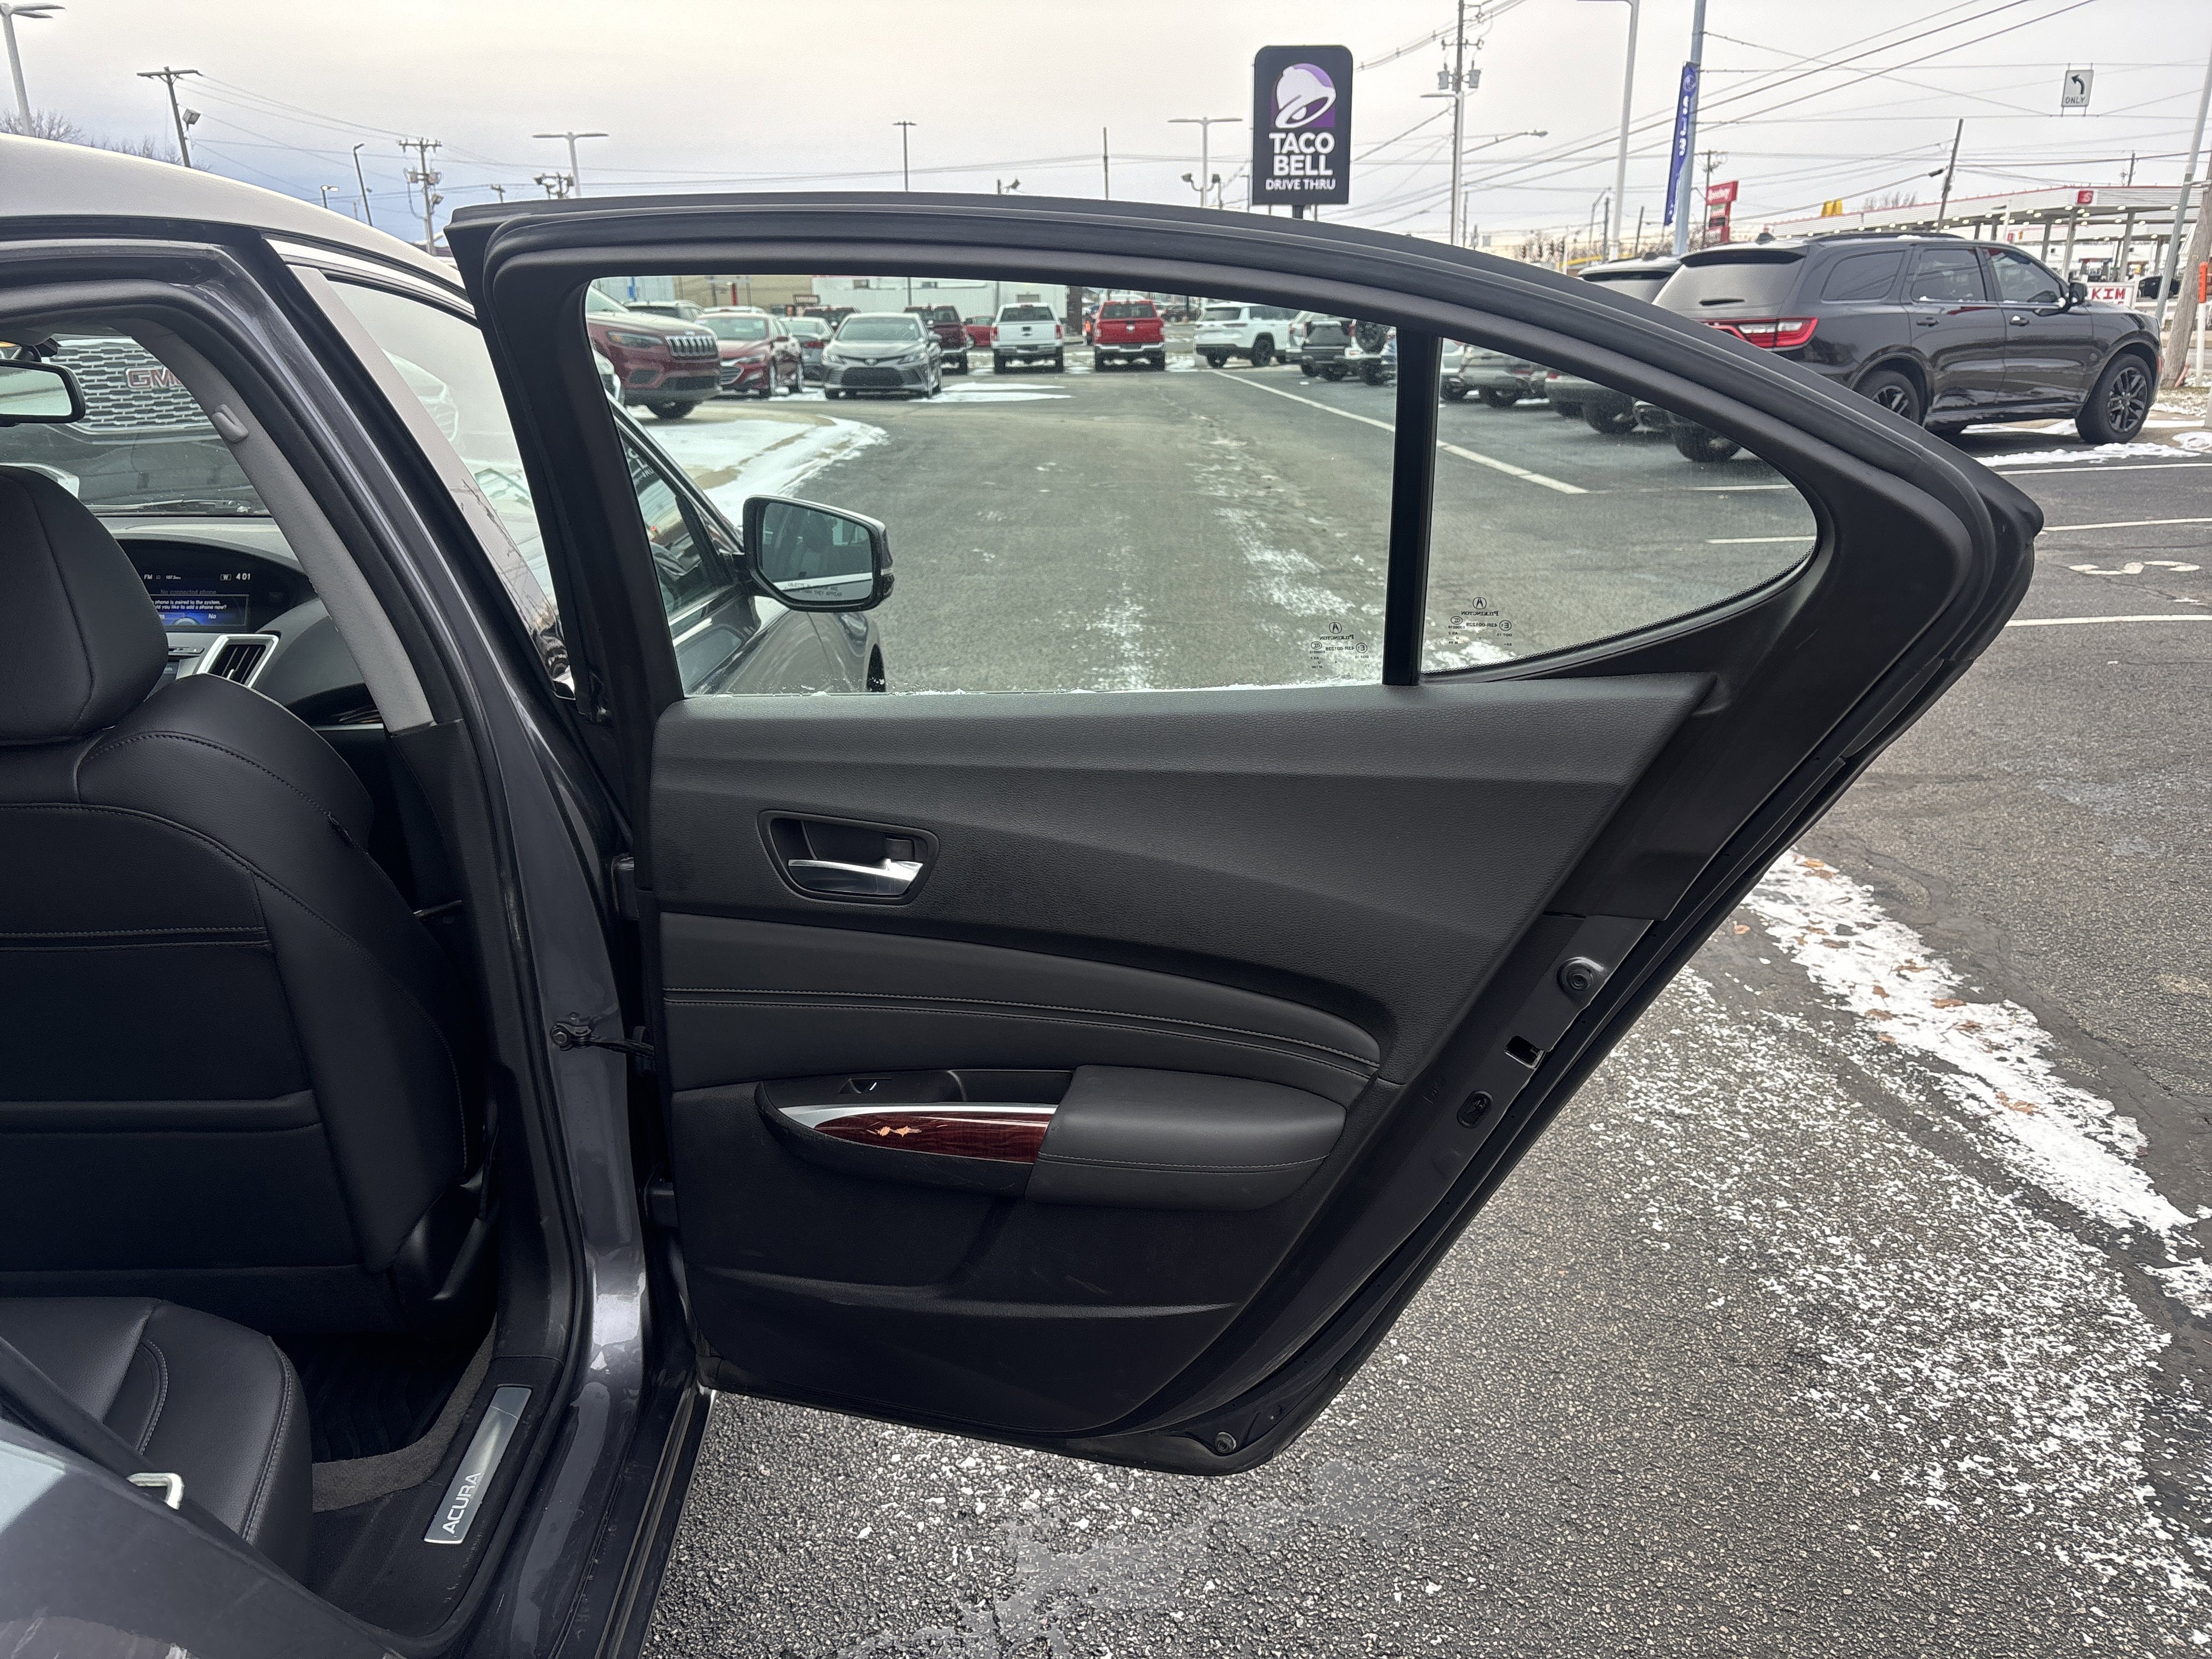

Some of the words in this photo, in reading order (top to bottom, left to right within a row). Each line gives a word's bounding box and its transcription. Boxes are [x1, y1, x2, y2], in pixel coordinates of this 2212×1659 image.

[1268, 132, 1335, 154] TACO
[1273, 155, 1333, 176] BELL
[1266, 178, 1301, 190] DRIVE
[1302, 178, 1336, 190] THRU
[2091, 287, 2126, 300] KIM
[126, 366, 183, 388] GM
[442, 1472, 482, 1534] ACURA
